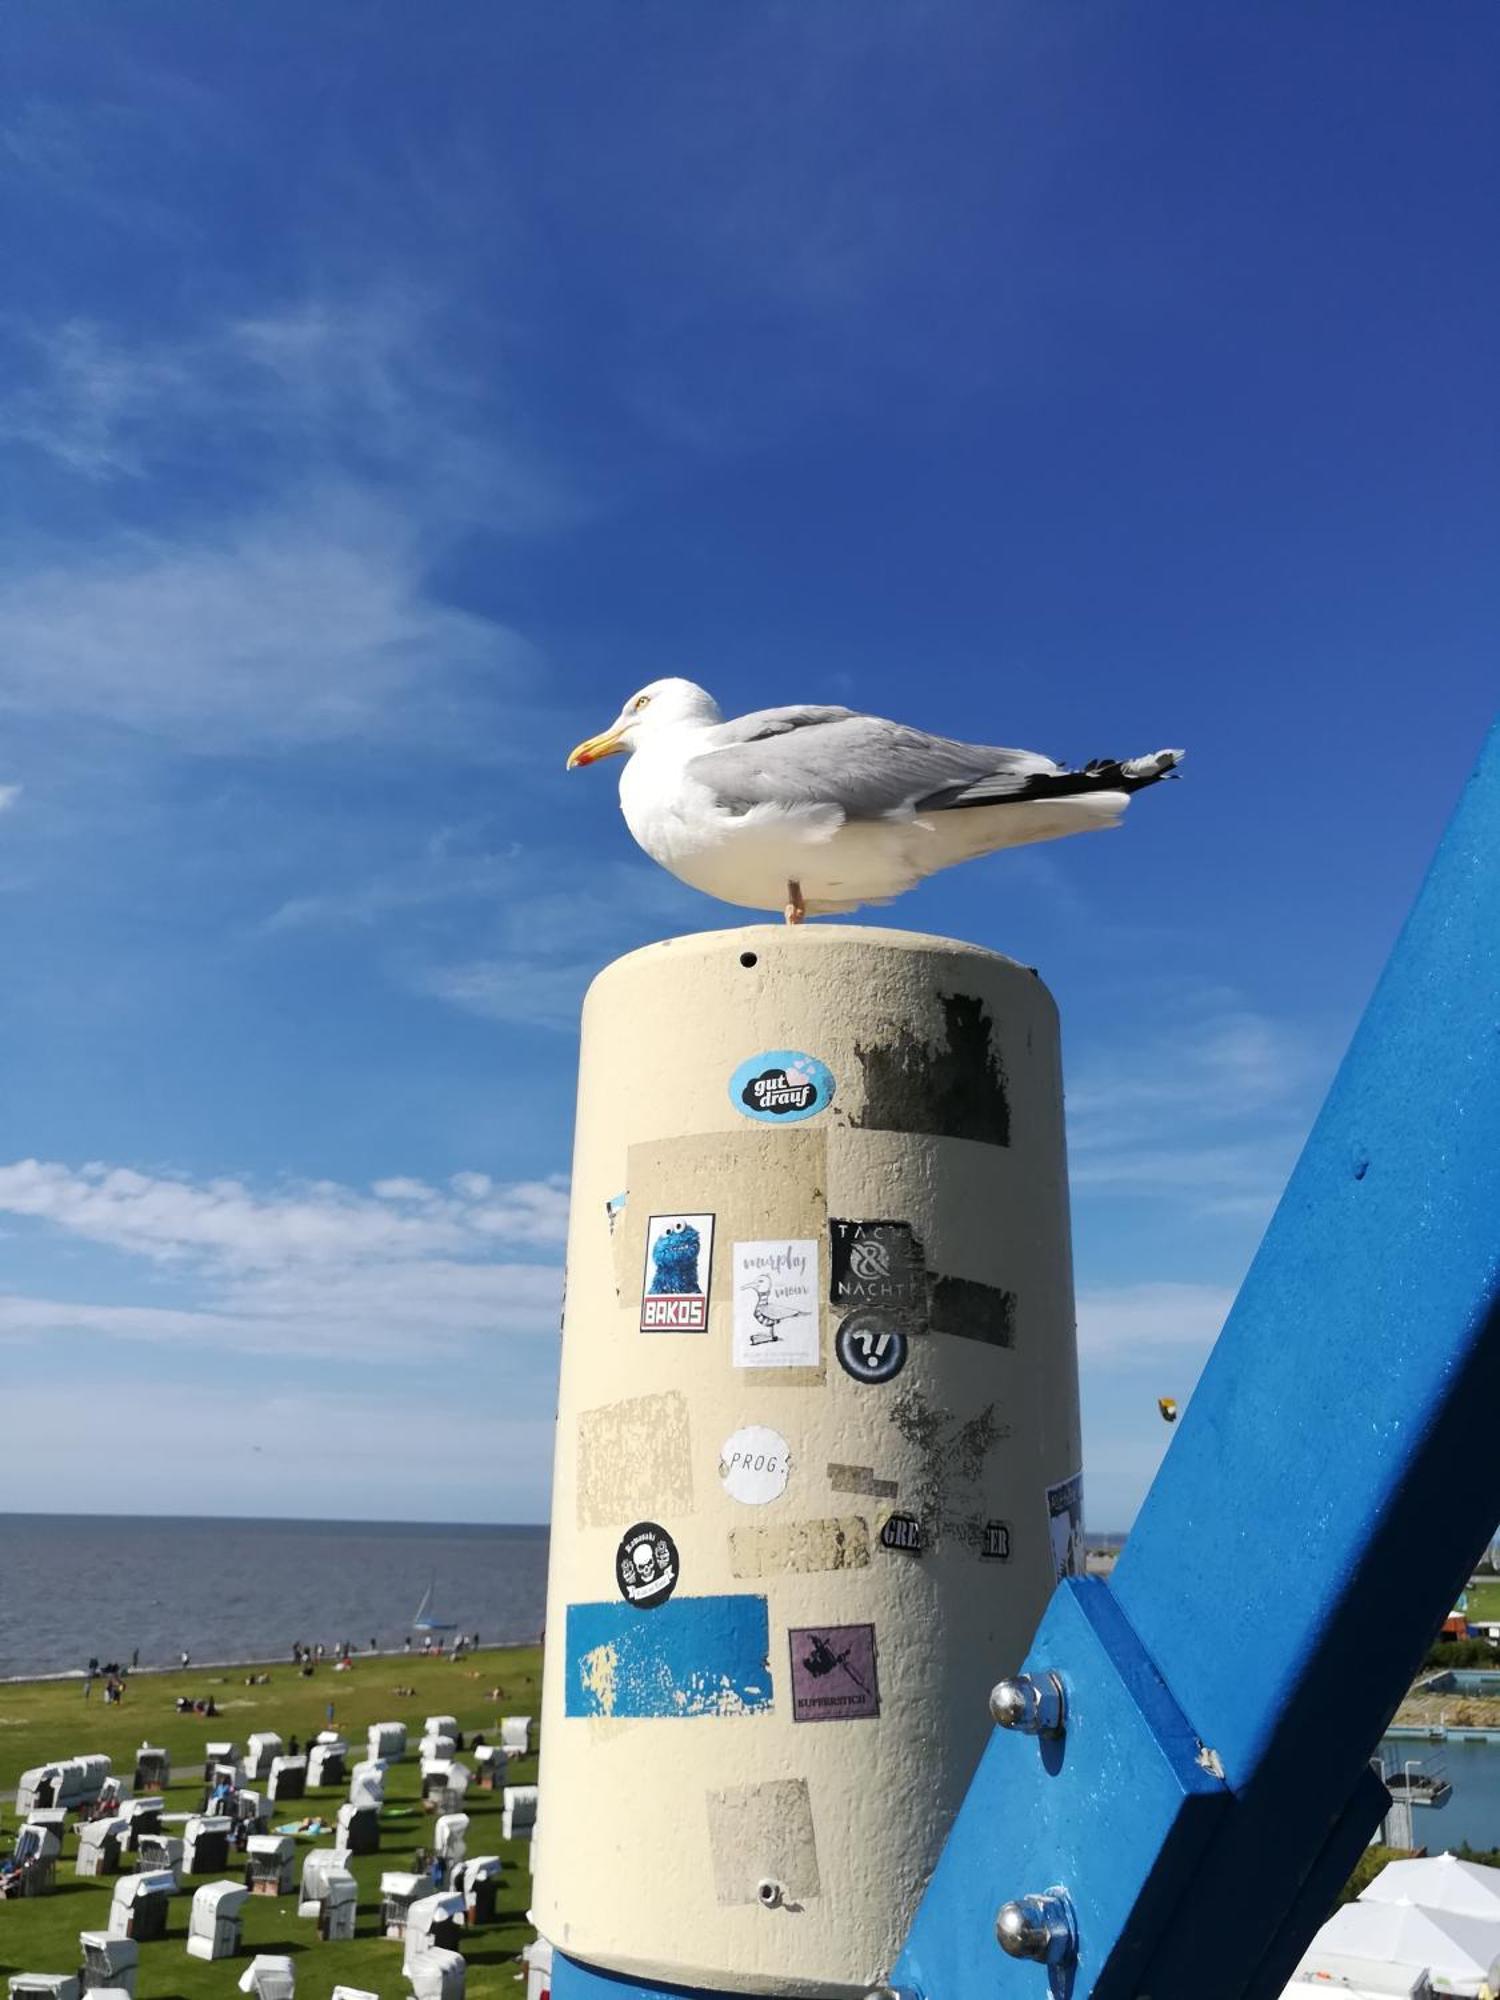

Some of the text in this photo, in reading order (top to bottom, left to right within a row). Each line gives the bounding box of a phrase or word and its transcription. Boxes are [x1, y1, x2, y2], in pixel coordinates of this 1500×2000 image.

[753, 1074, 787, 1096] gut
[759, 1086, 810, 1107] drauf
[838, 1224, 887, 1240] TAC
[838, 1281, 904, 1297] NACHT
[644, 1300, 703, 1325] BAKOS
[730, 1452, 784, 1474] PROG.
